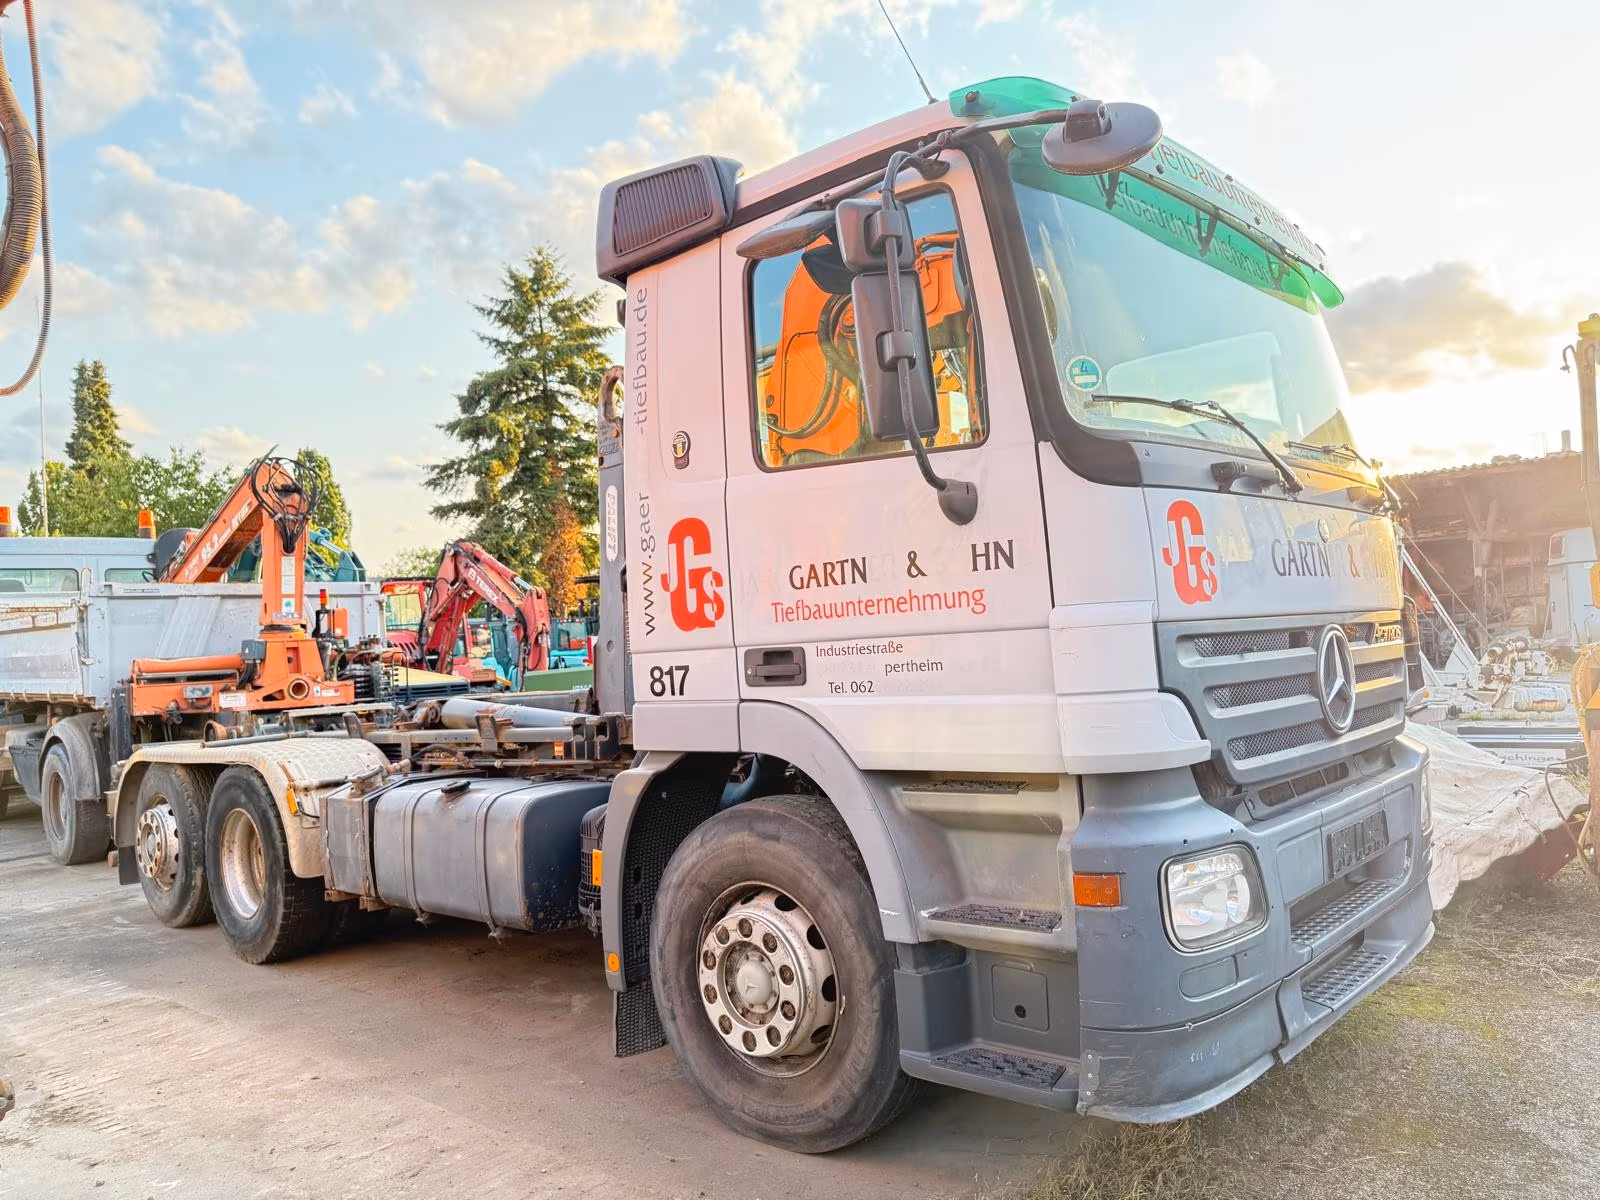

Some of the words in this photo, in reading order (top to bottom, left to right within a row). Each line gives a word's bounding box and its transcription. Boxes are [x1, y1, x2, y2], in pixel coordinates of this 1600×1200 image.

[633, 287, 648, 436] -tiefbau.de
[639, 492, 656, 637] www.gaer
[789, 556, 868, 591] GARTN
[906, 550, 928, 578] &
[970, 539, 1016, 572] HN
[1271, 539, 1331, 577] GARTN
[476, 575, 499, 604] TEREX
[770, 587, 987, 624] Tiefbauunternehmung
[815, 640, 904, 658] Industriestraße
[649, 665, 690, 697] 817
[884, 660, 944, 677] pertheim
[828, 680, 848, 695] Tel.
[850, 680, 875, 694] 062
